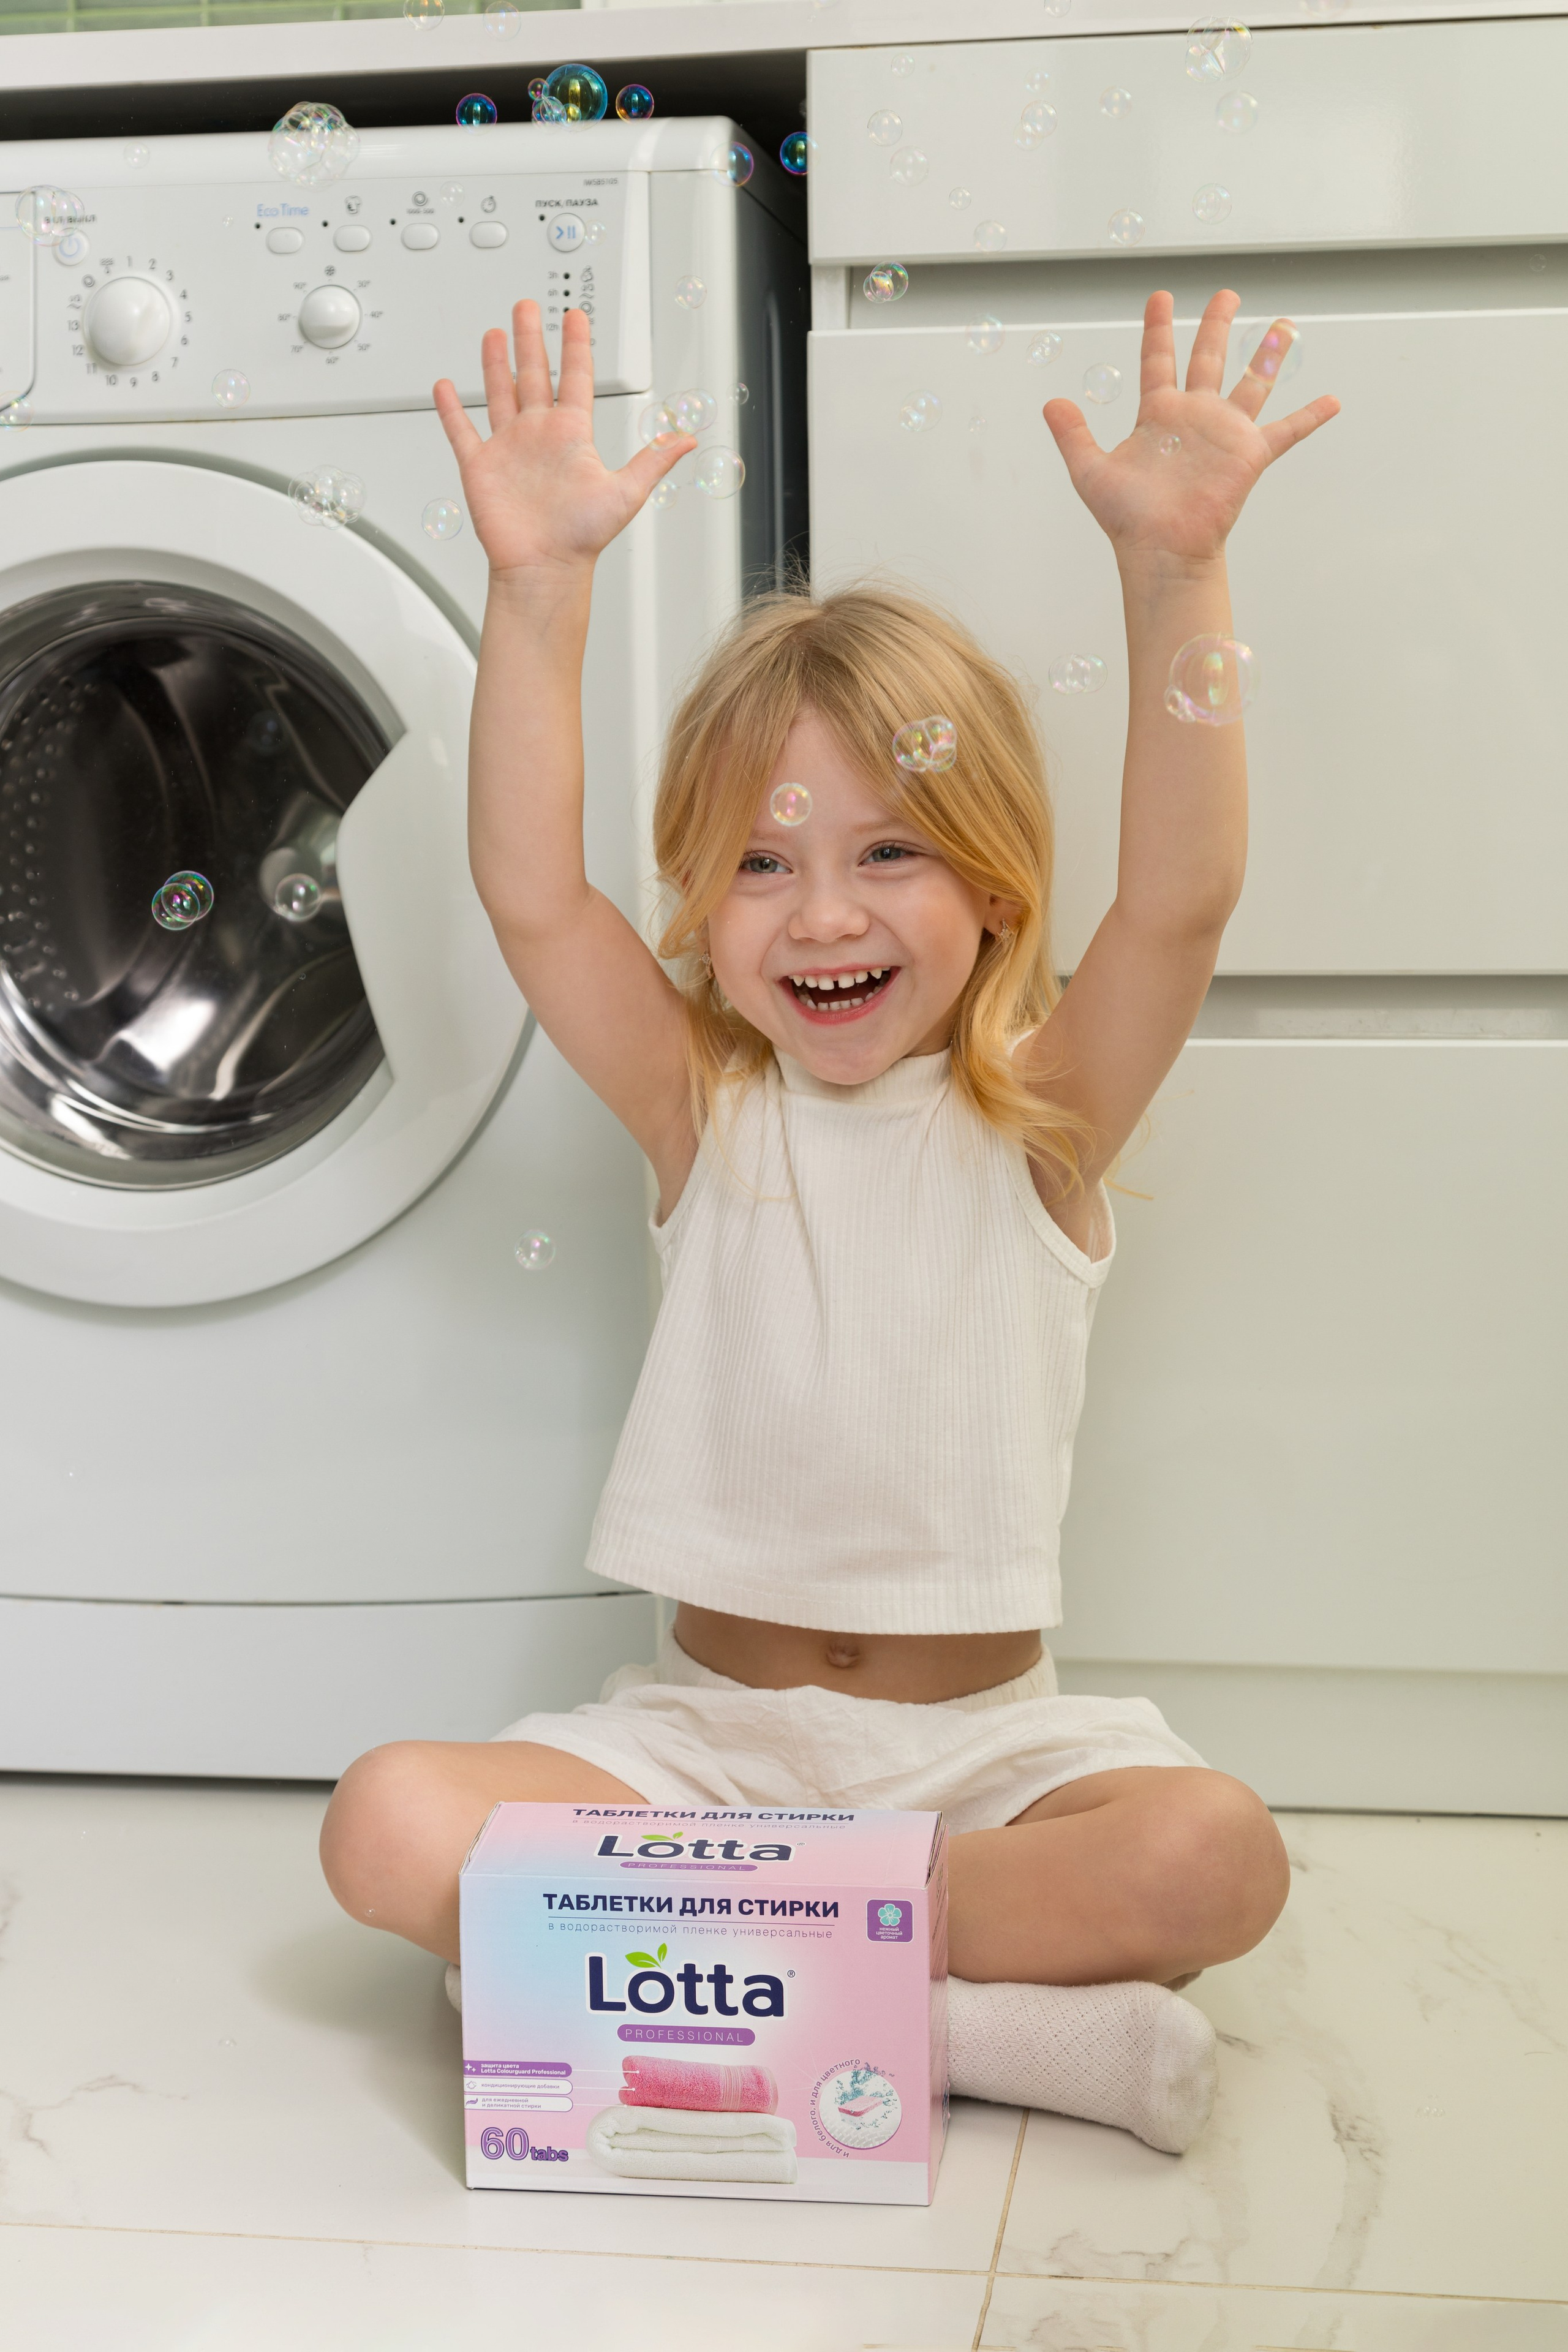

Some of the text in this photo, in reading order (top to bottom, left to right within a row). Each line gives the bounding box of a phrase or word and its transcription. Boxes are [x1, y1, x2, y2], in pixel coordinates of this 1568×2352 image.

[257, 203, 309, 217] Eco Time
[127, 256, 132, 267] 1
[149, 258, 156, 270] 2
[167, 270, 173, 281] 3
[179, 289, 187, 300] 4
[185, 311, 192, 322] 5
[67, 320, 79, 331] 13
[181, 335, 188, 345] 6
[72, 345, 84, 356] 12
[172, 357, 178, 368] 7
[86, 363, 97, 374] 11
[105, 374, 118, 386] 10
[130, 377, 137, 387] 9
[152, 371, 159, 382] 8
[573, 1809, 696, 1819] ТАБЛЕТКИ
[758, 1812, 855, 1822] СТИРКИ
[543, 1893, 839, 1918] ТАБЛЕТКИ ДЛЯ СТИРКИ
[560, 1923, 677, 1934] водорастворимой
[683, 1927, 727, 1936] пленке
[733, 1928, 832, 1939] универсальные
[625, 2029, 744, 2043] PROFESSIONAL
[820, 2059, 861, 2081] цветного
[811, 2081, 823, 2098] для
[481, 2127, 569, 2162] 60 tabs
[826, 2140, 843, 2154] для
